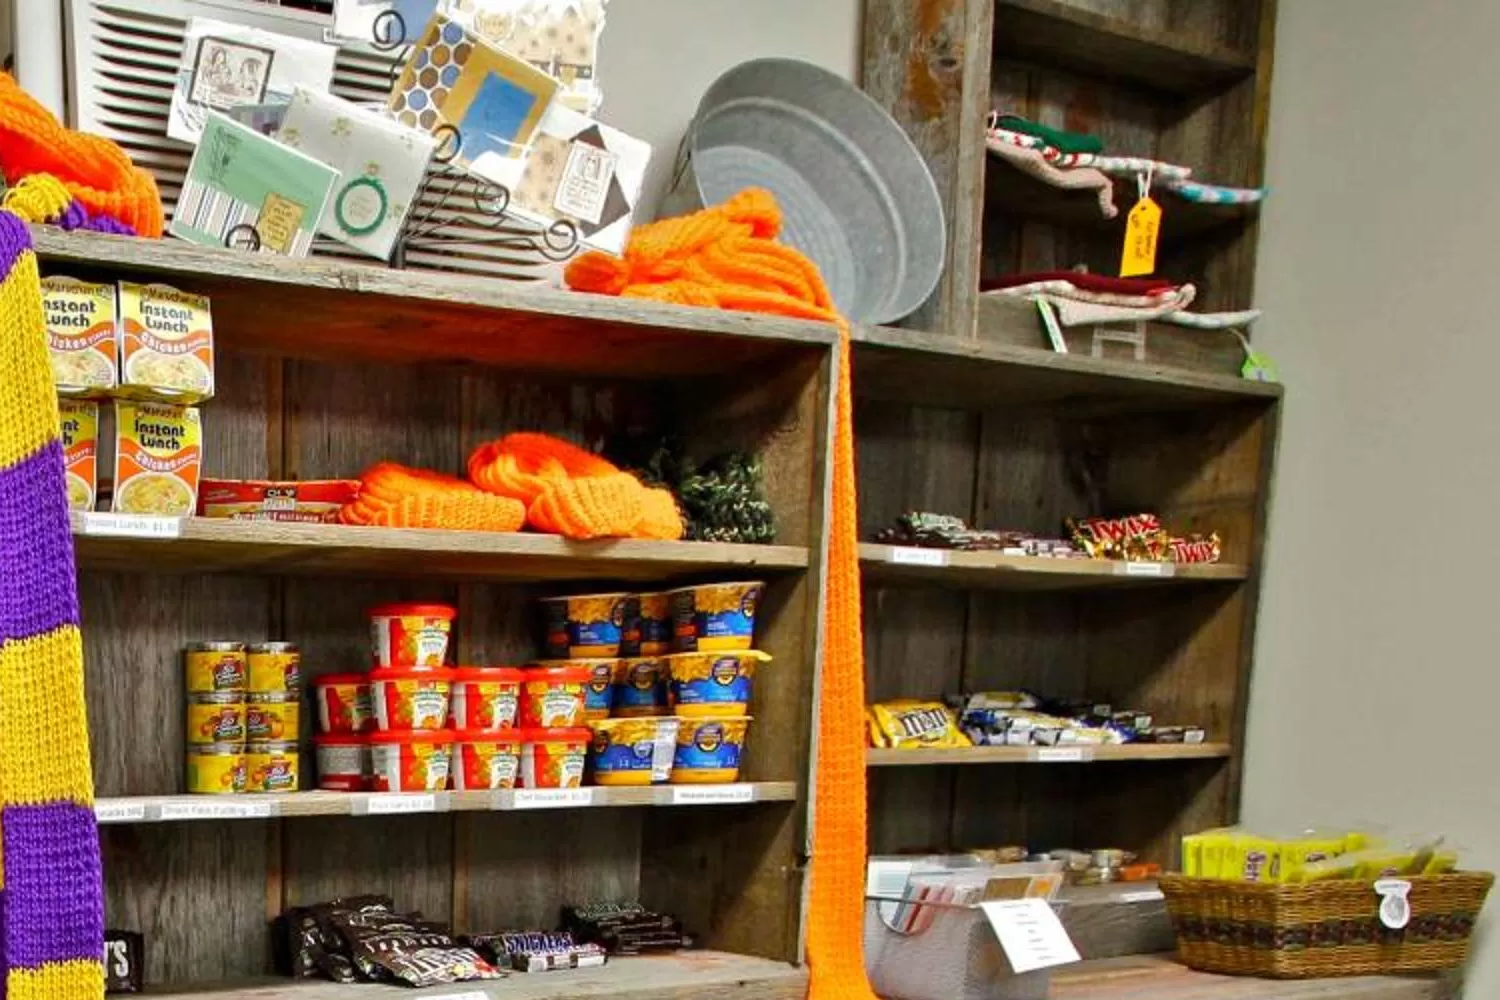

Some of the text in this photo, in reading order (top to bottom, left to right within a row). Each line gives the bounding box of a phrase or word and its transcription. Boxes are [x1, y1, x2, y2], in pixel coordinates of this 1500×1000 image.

[44, 300, 96, 313] nstant
[140, 301, 193, 320] Instant
[145, 316, 189, 333] Lunch
[135, 420, 185, 437] Instant
[140, 435, 180, 449] Lunch
[503, 933, 573, 954] SNICKERS
